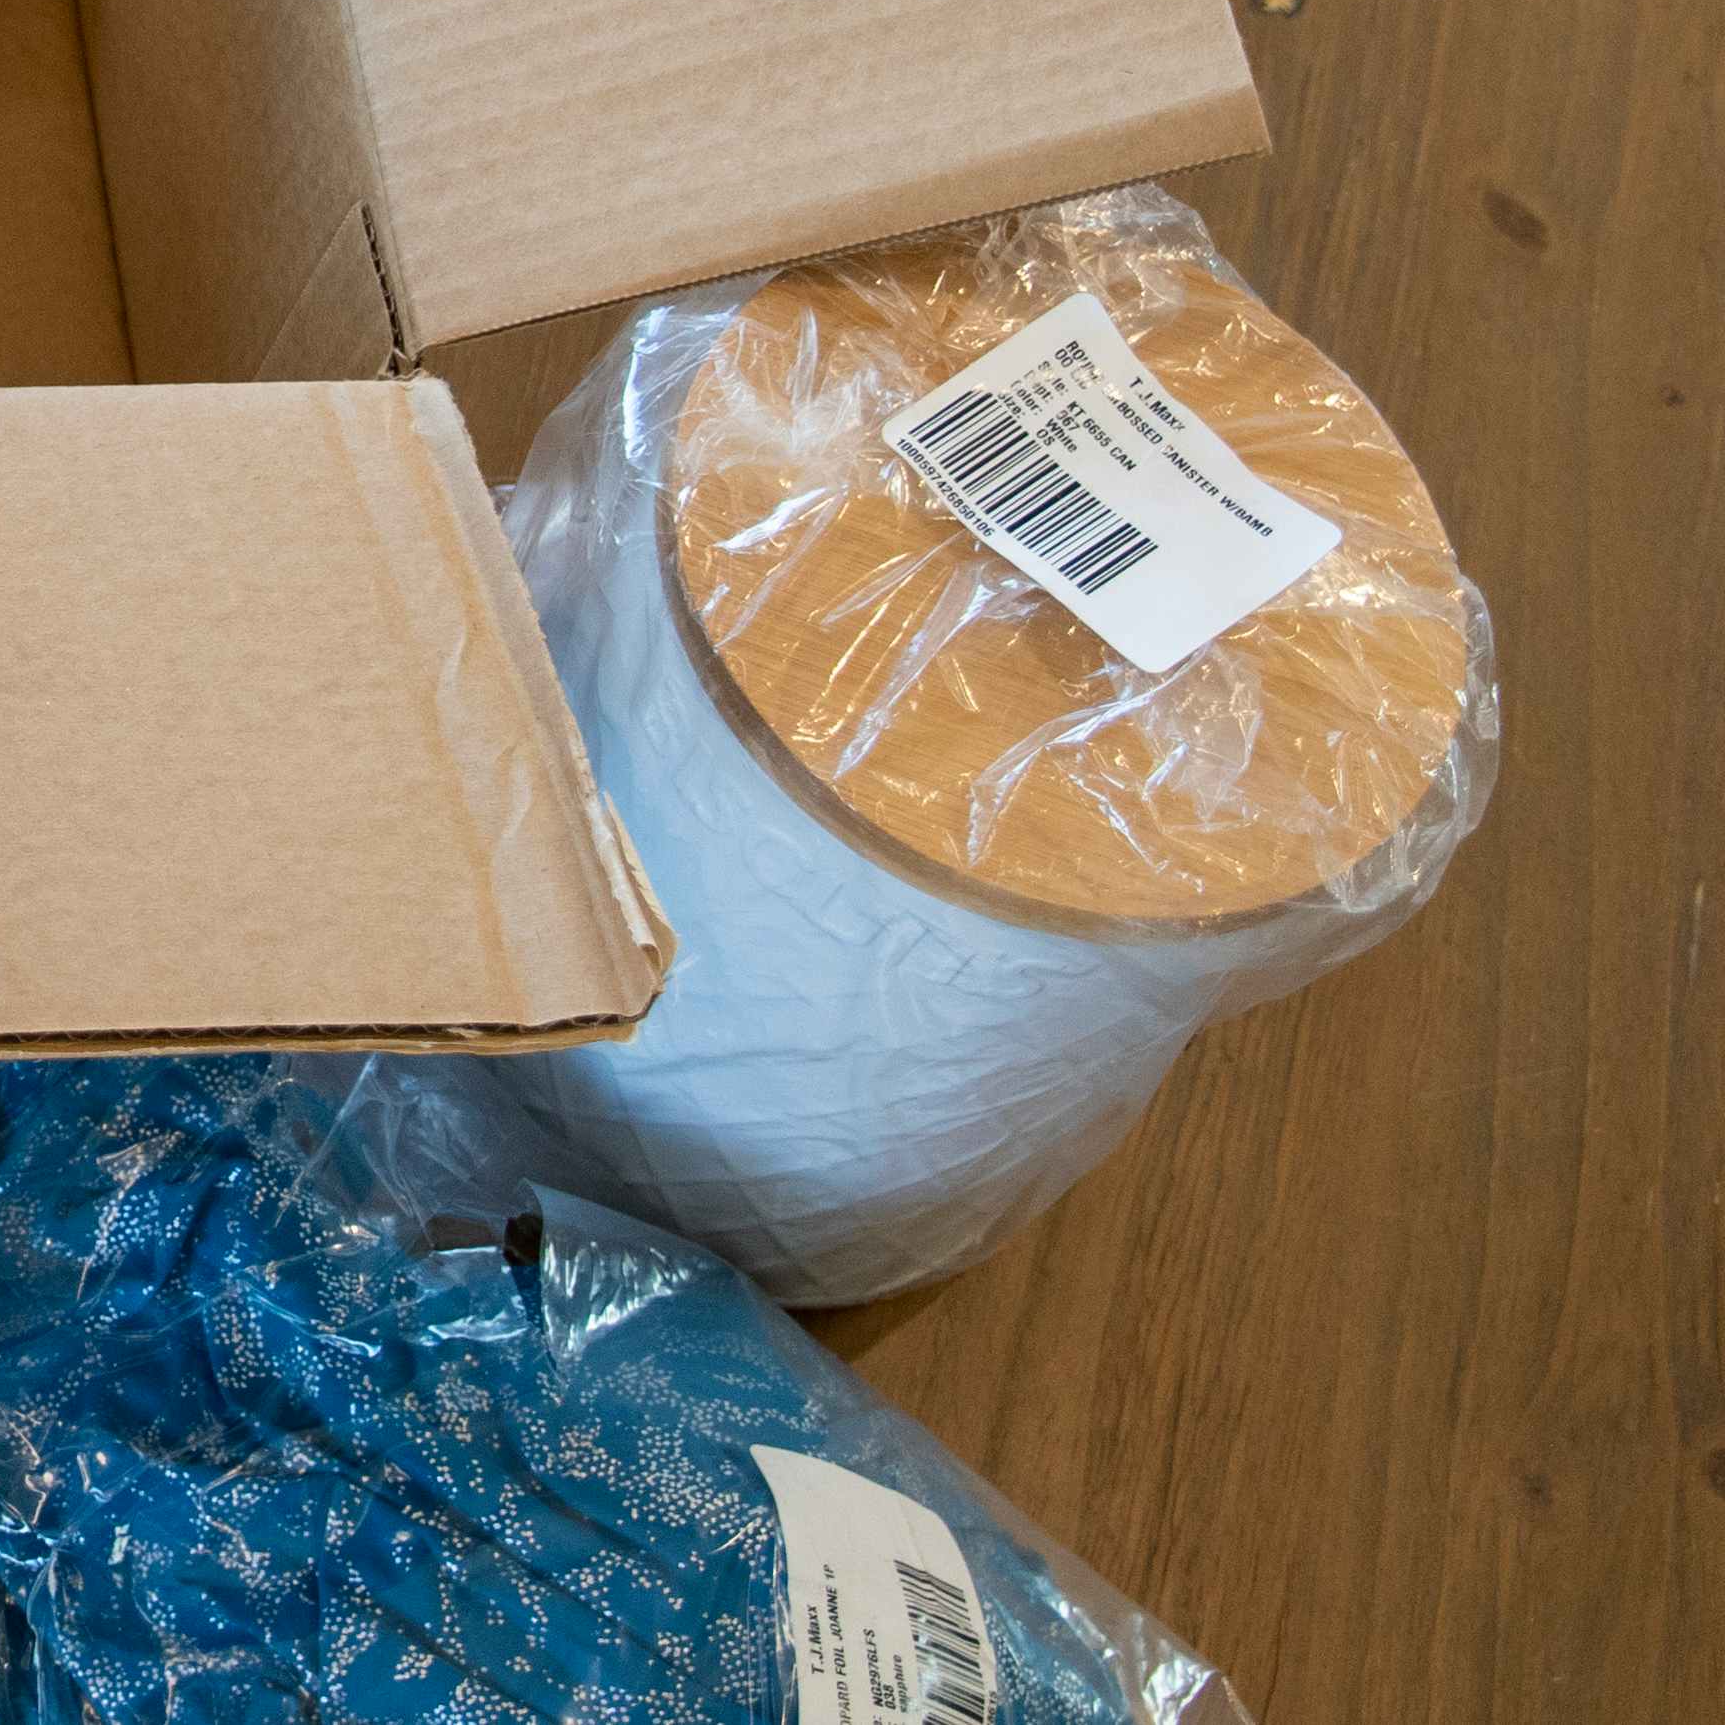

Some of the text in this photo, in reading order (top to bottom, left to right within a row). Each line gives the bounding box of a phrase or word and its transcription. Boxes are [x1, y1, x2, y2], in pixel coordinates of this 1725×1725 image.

[1037, 359, 1137, 471] Sle: KT 6655 CAN
[1129, 376, 1185, 430] T.J.Maxx
[1042, 417, 1078, 452] White
[1101, 384, 1165, 448] BOSSED
[1219, 495, 1274, 537] W/BAMB
[896, 438, 995, 537] 1000597426850106
[825, 1563, 837, 1583] 1P
[807, 1604, 825, 1675] T.J.Maxx
[828, 1584, 843, 1641] JOANNE
[835, 1646, 847, 1676] FOIL
[863, 1628, 883, 1706] NG2976LFS
[893, 1655, 908, 1713] sapphire
